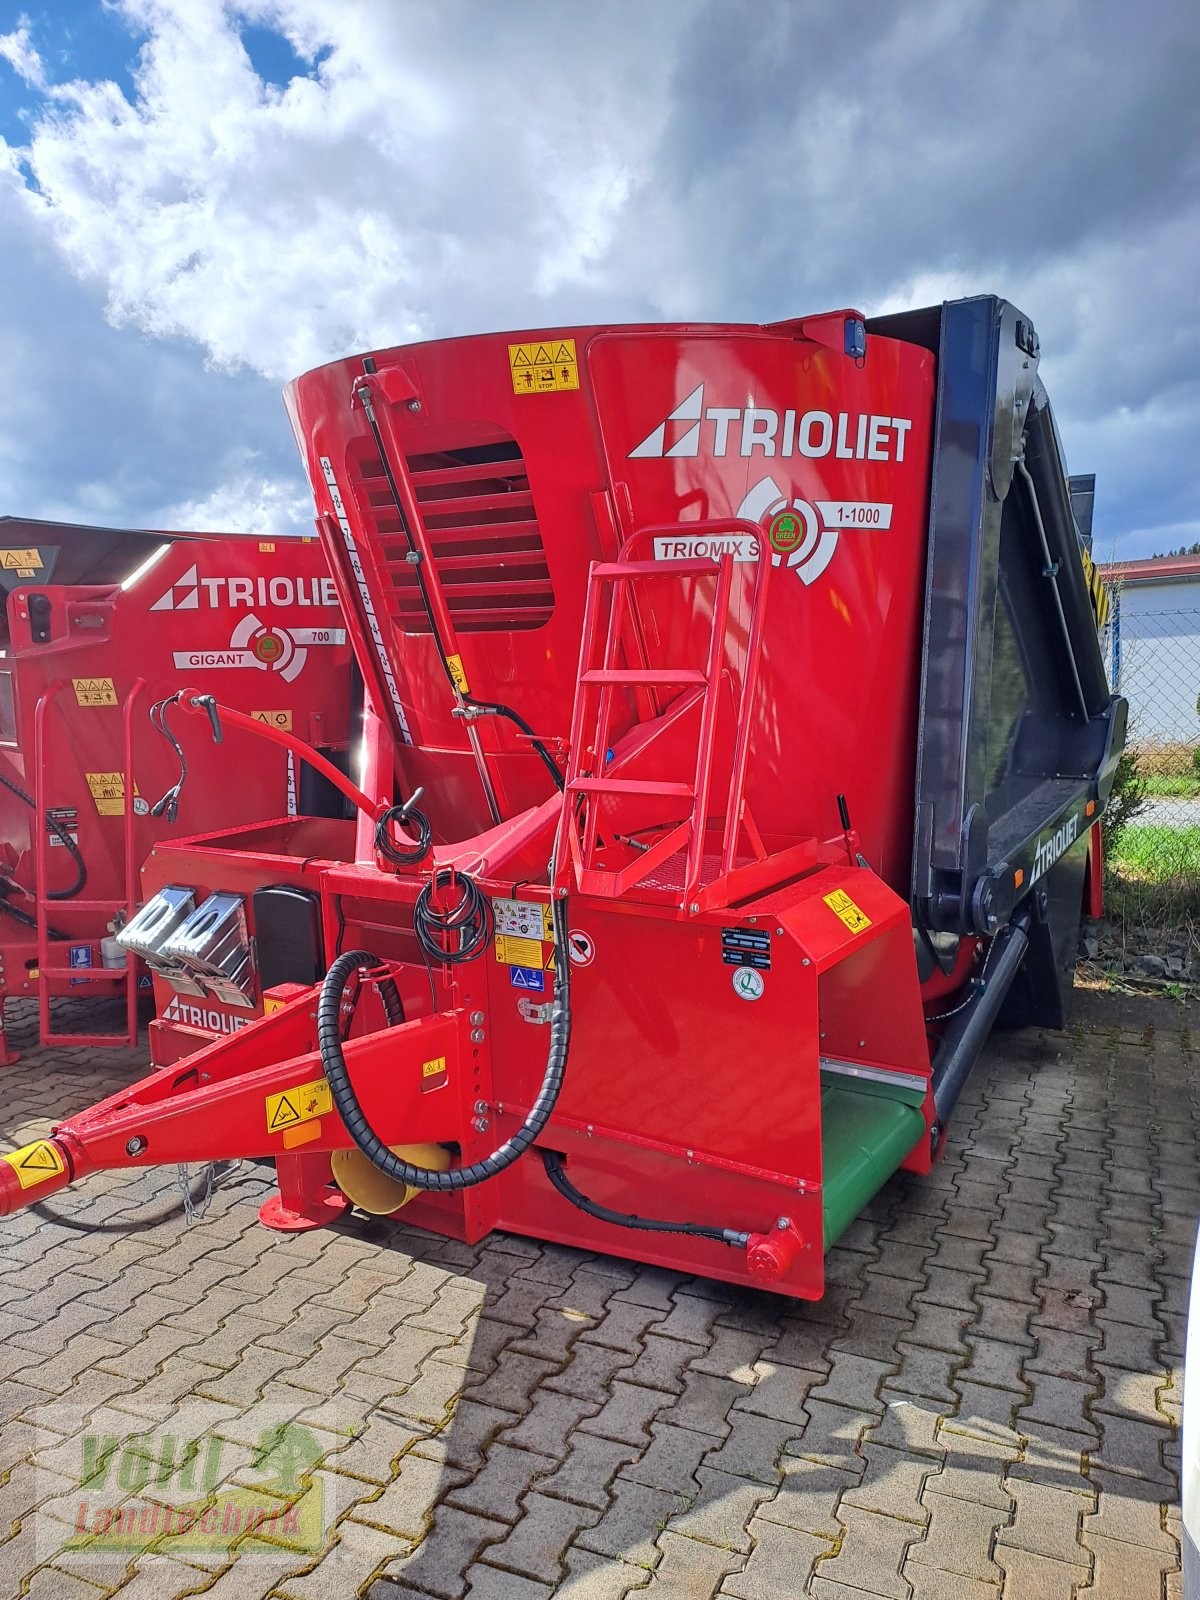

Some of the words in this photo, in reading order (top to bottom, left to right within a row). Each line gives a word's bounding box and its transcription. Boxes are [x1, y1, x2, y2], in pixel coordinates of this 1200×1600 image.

[705, 407, 913, 463] TRIOLIET
[333, 494, 341, 509] 8
[836, 506, 881, 525] 1-1000
[343, 527, 350, 541] 7
[660, 540, 743, 558] TRIOMIX
[748, 540, 760, 557] S
[353, 560, 361, 574] 6
[200, 576, 341, 608] TRIOLIE
[362, 591, 370, 605] 5
[372, 622, 379, 636] 4
[311, 631, 330, 642] 700
[188, 653, 245, 666] GIGANT
[380, 653, 388, 666] 3
[389, 683, 397, 695] 2
[1040, 812, 1079, 874] TRIOLIET
